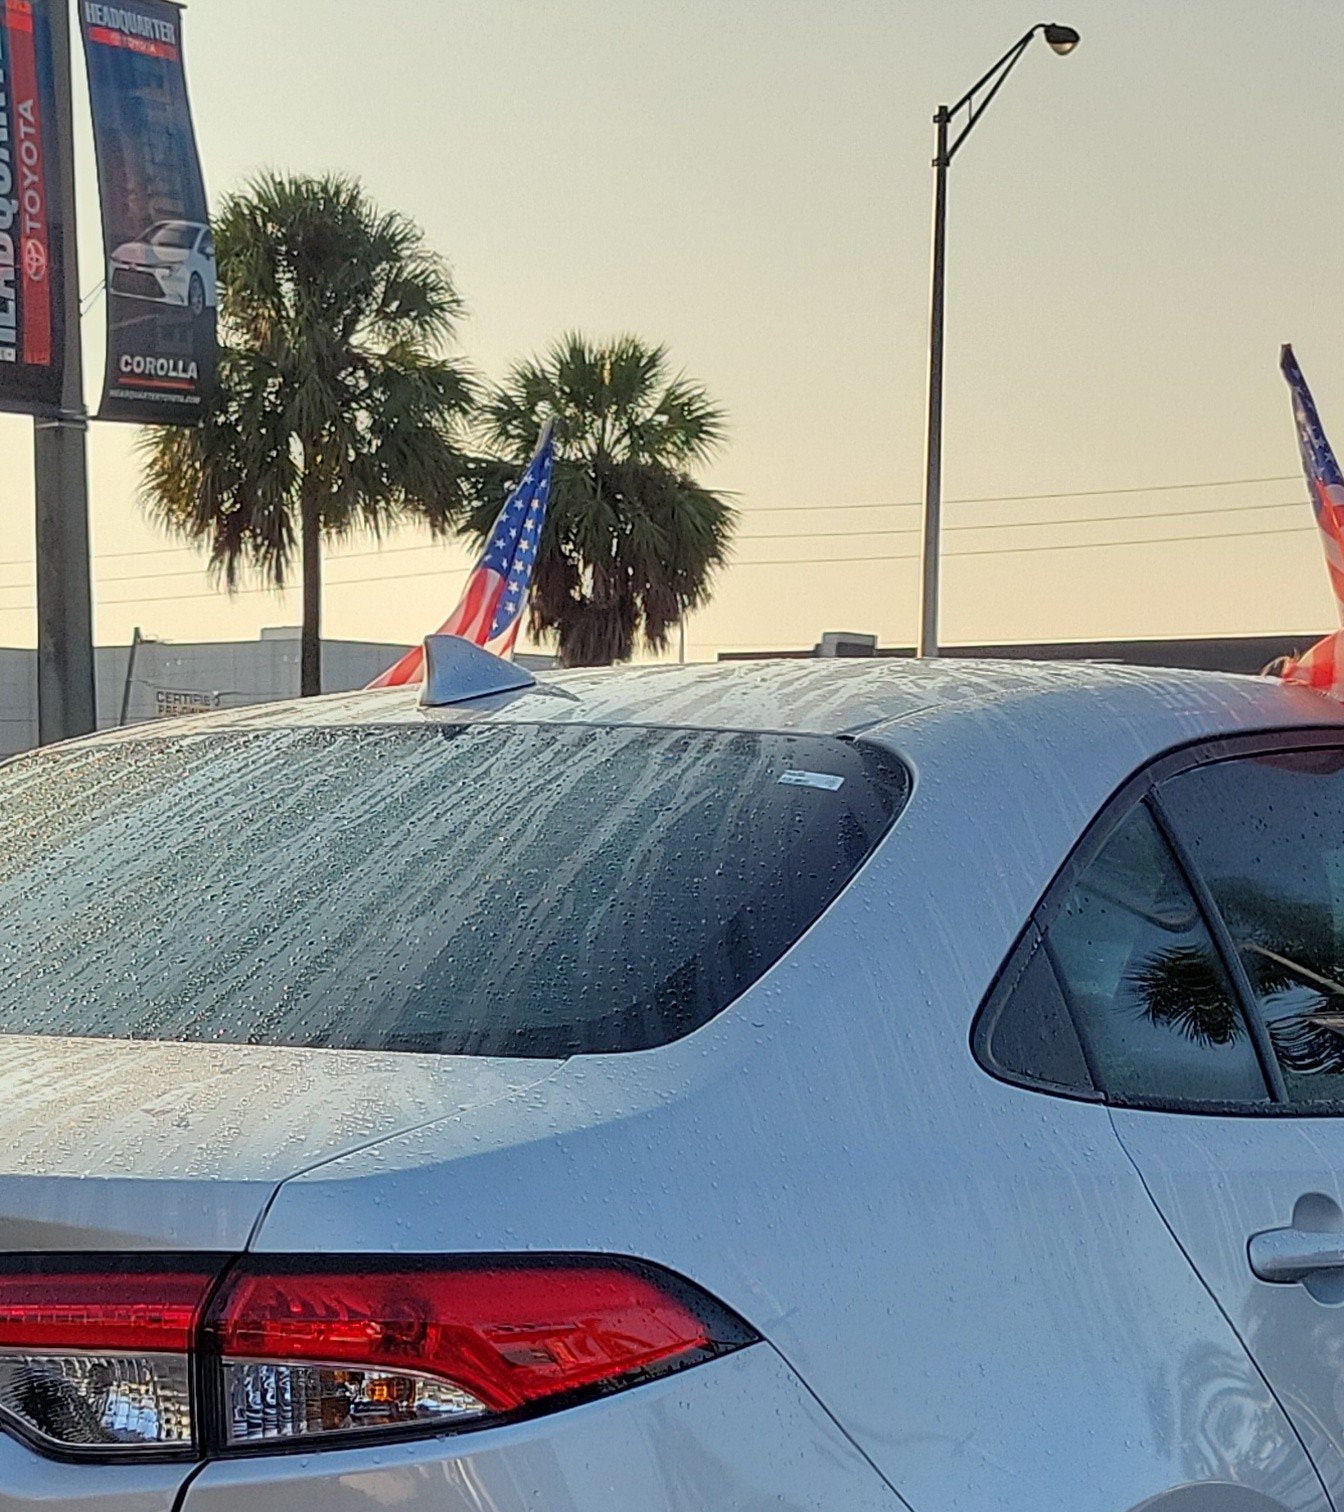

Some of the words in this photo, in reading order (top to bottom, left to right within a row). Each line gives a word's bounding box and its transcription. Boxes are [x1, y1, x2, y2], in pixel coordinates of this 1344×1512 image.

[84, 1, 176, 44] HEADQUARTER
[17, 99, 43, 231] TOYOTA
[119, 354, 198, 379] COROLLA
